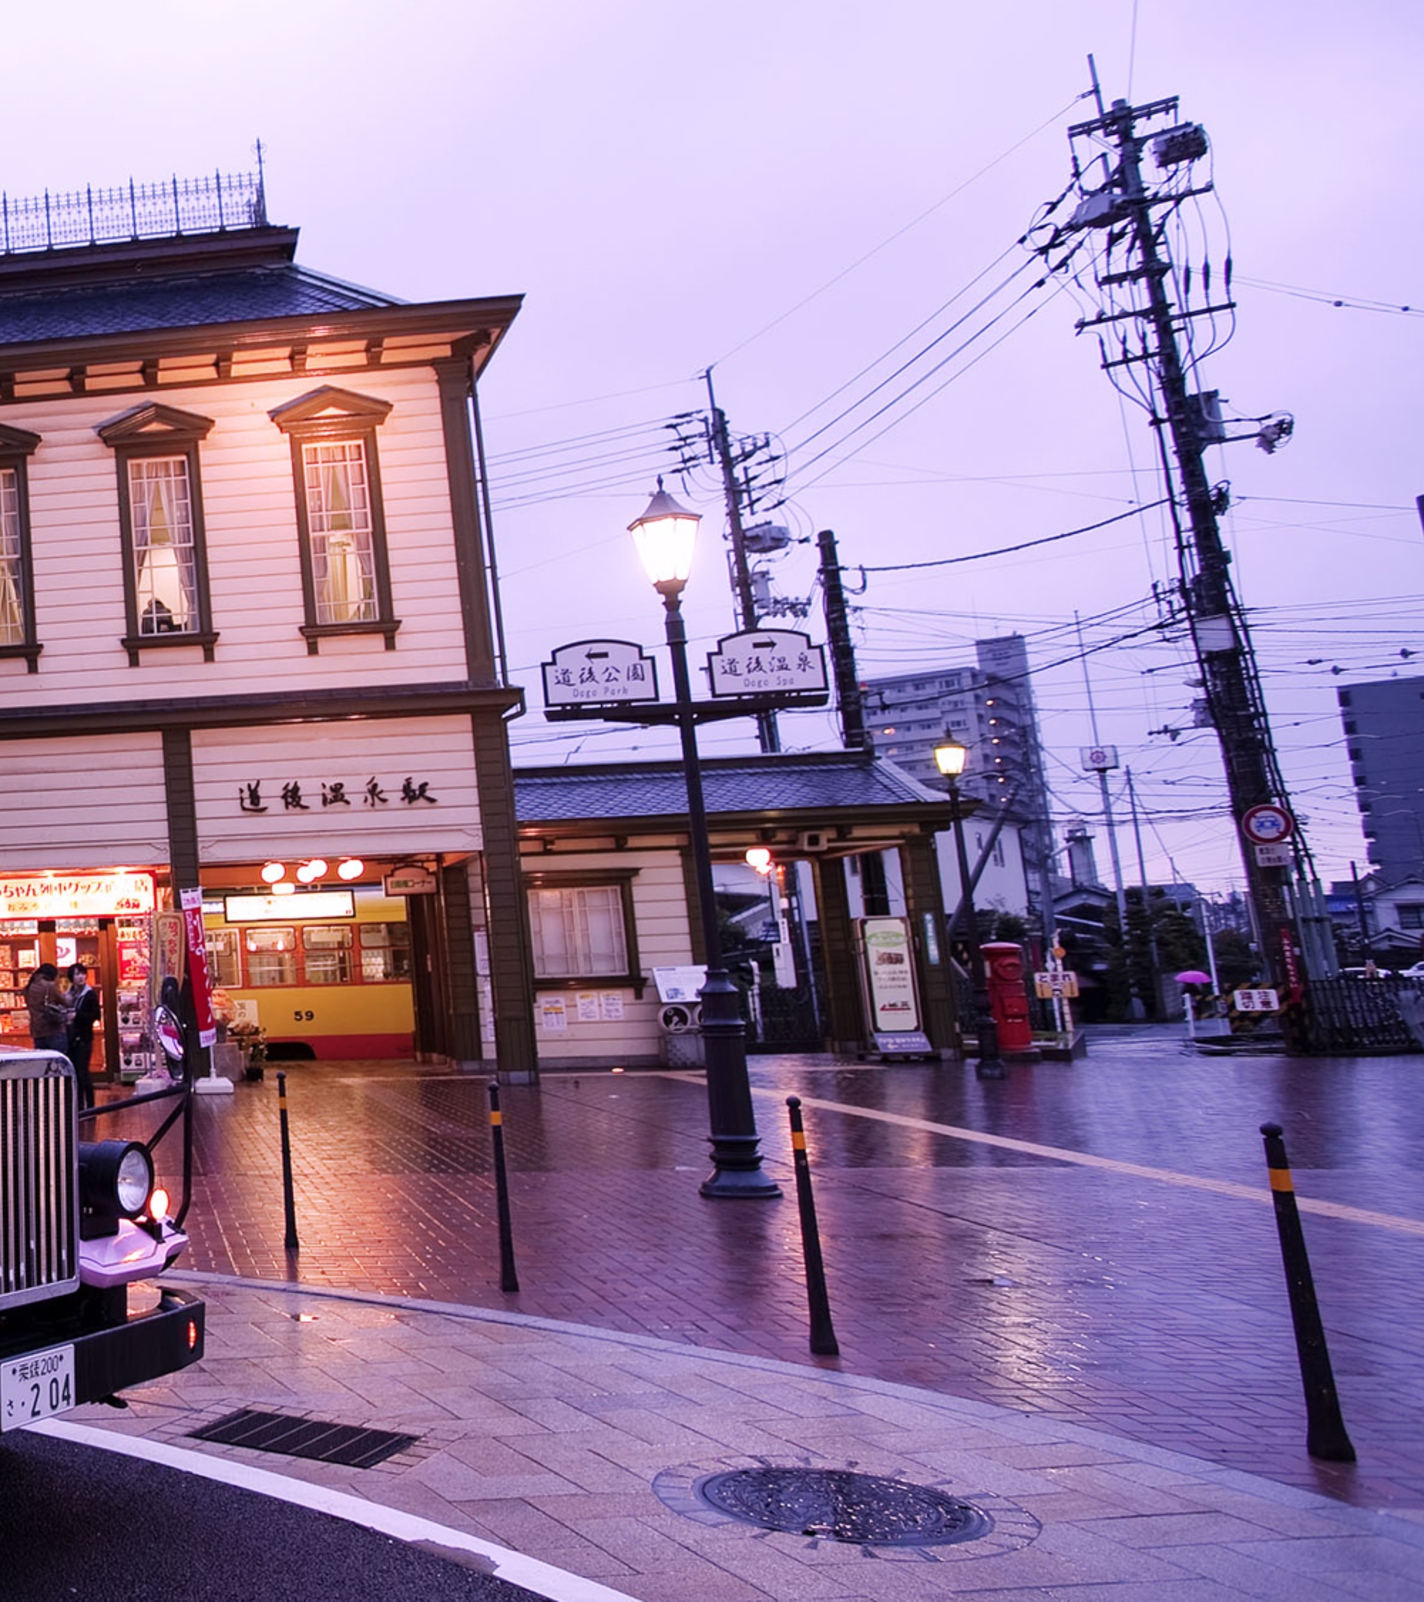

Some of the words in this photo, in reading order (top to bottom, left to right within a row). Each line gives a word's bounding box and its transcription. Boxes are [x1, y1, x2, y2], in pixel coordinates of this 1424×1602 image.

[554, 662, 646, 687] 道後公園
[720, 652, 816, 676] 道後温泉
[238, 775, 438, 813] 道後温泉駅
[294, 1011, 315, 1022] 59
